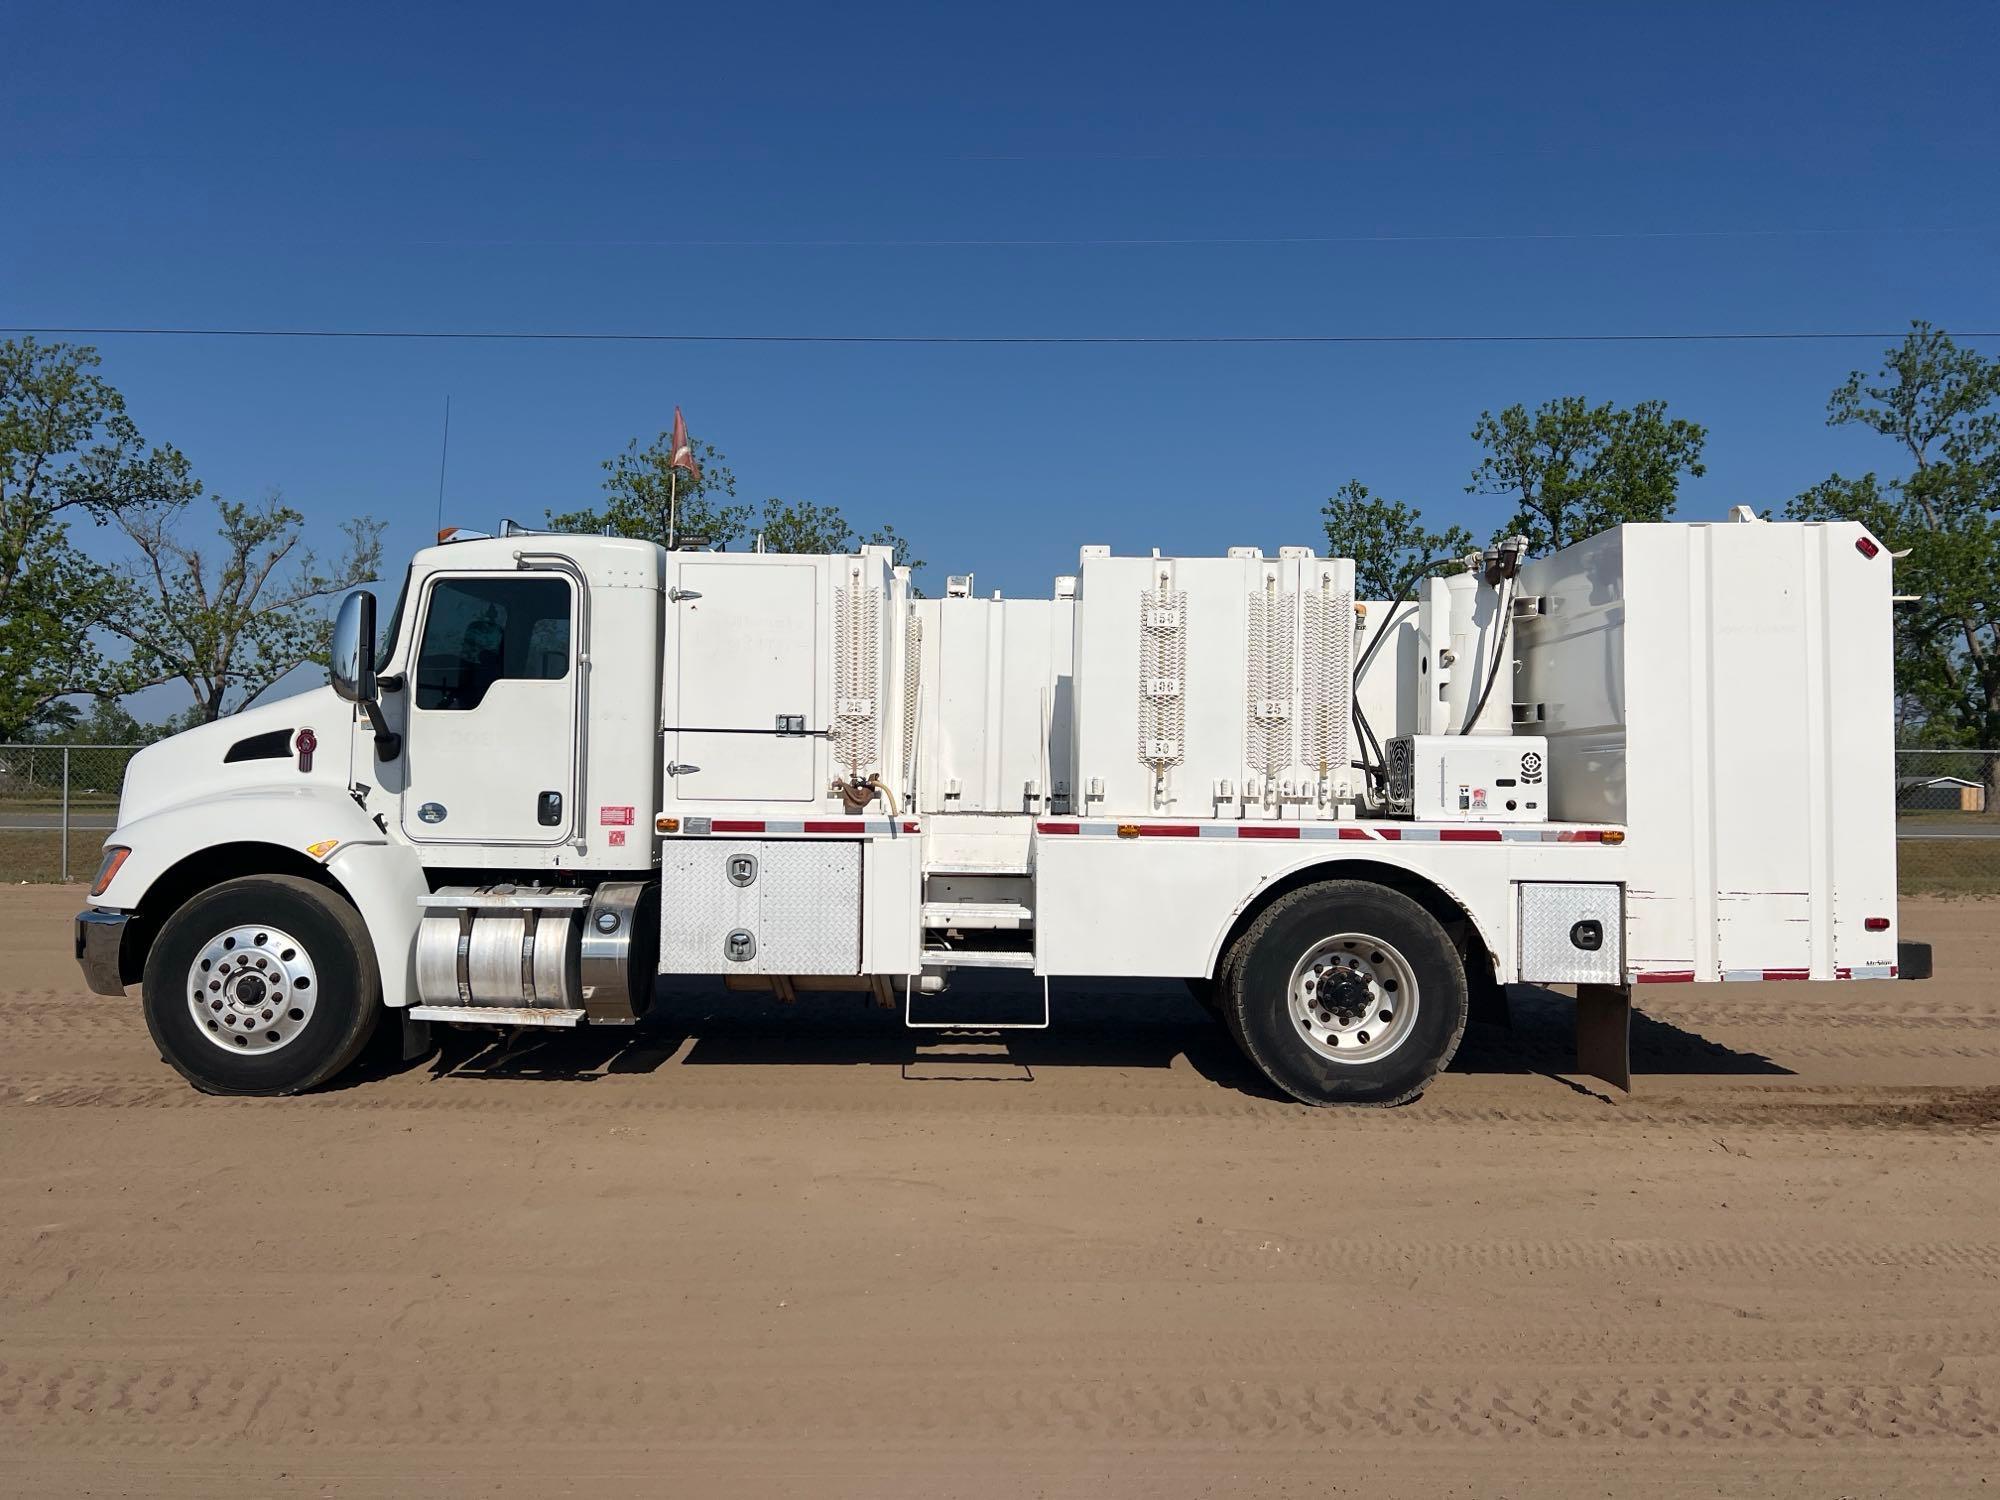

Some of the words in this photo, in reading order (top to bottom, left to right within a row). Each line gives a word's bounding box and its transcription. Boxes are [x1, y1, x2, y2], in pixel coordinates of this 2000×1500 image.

[1153, 612, 1174, 624] 150
[1153, 681, 1174, 692] 100
[847, 701, 862, 712] 25
[1265, 702, 1282, 714] 25
[1155, 742, 1169, 754] 50
